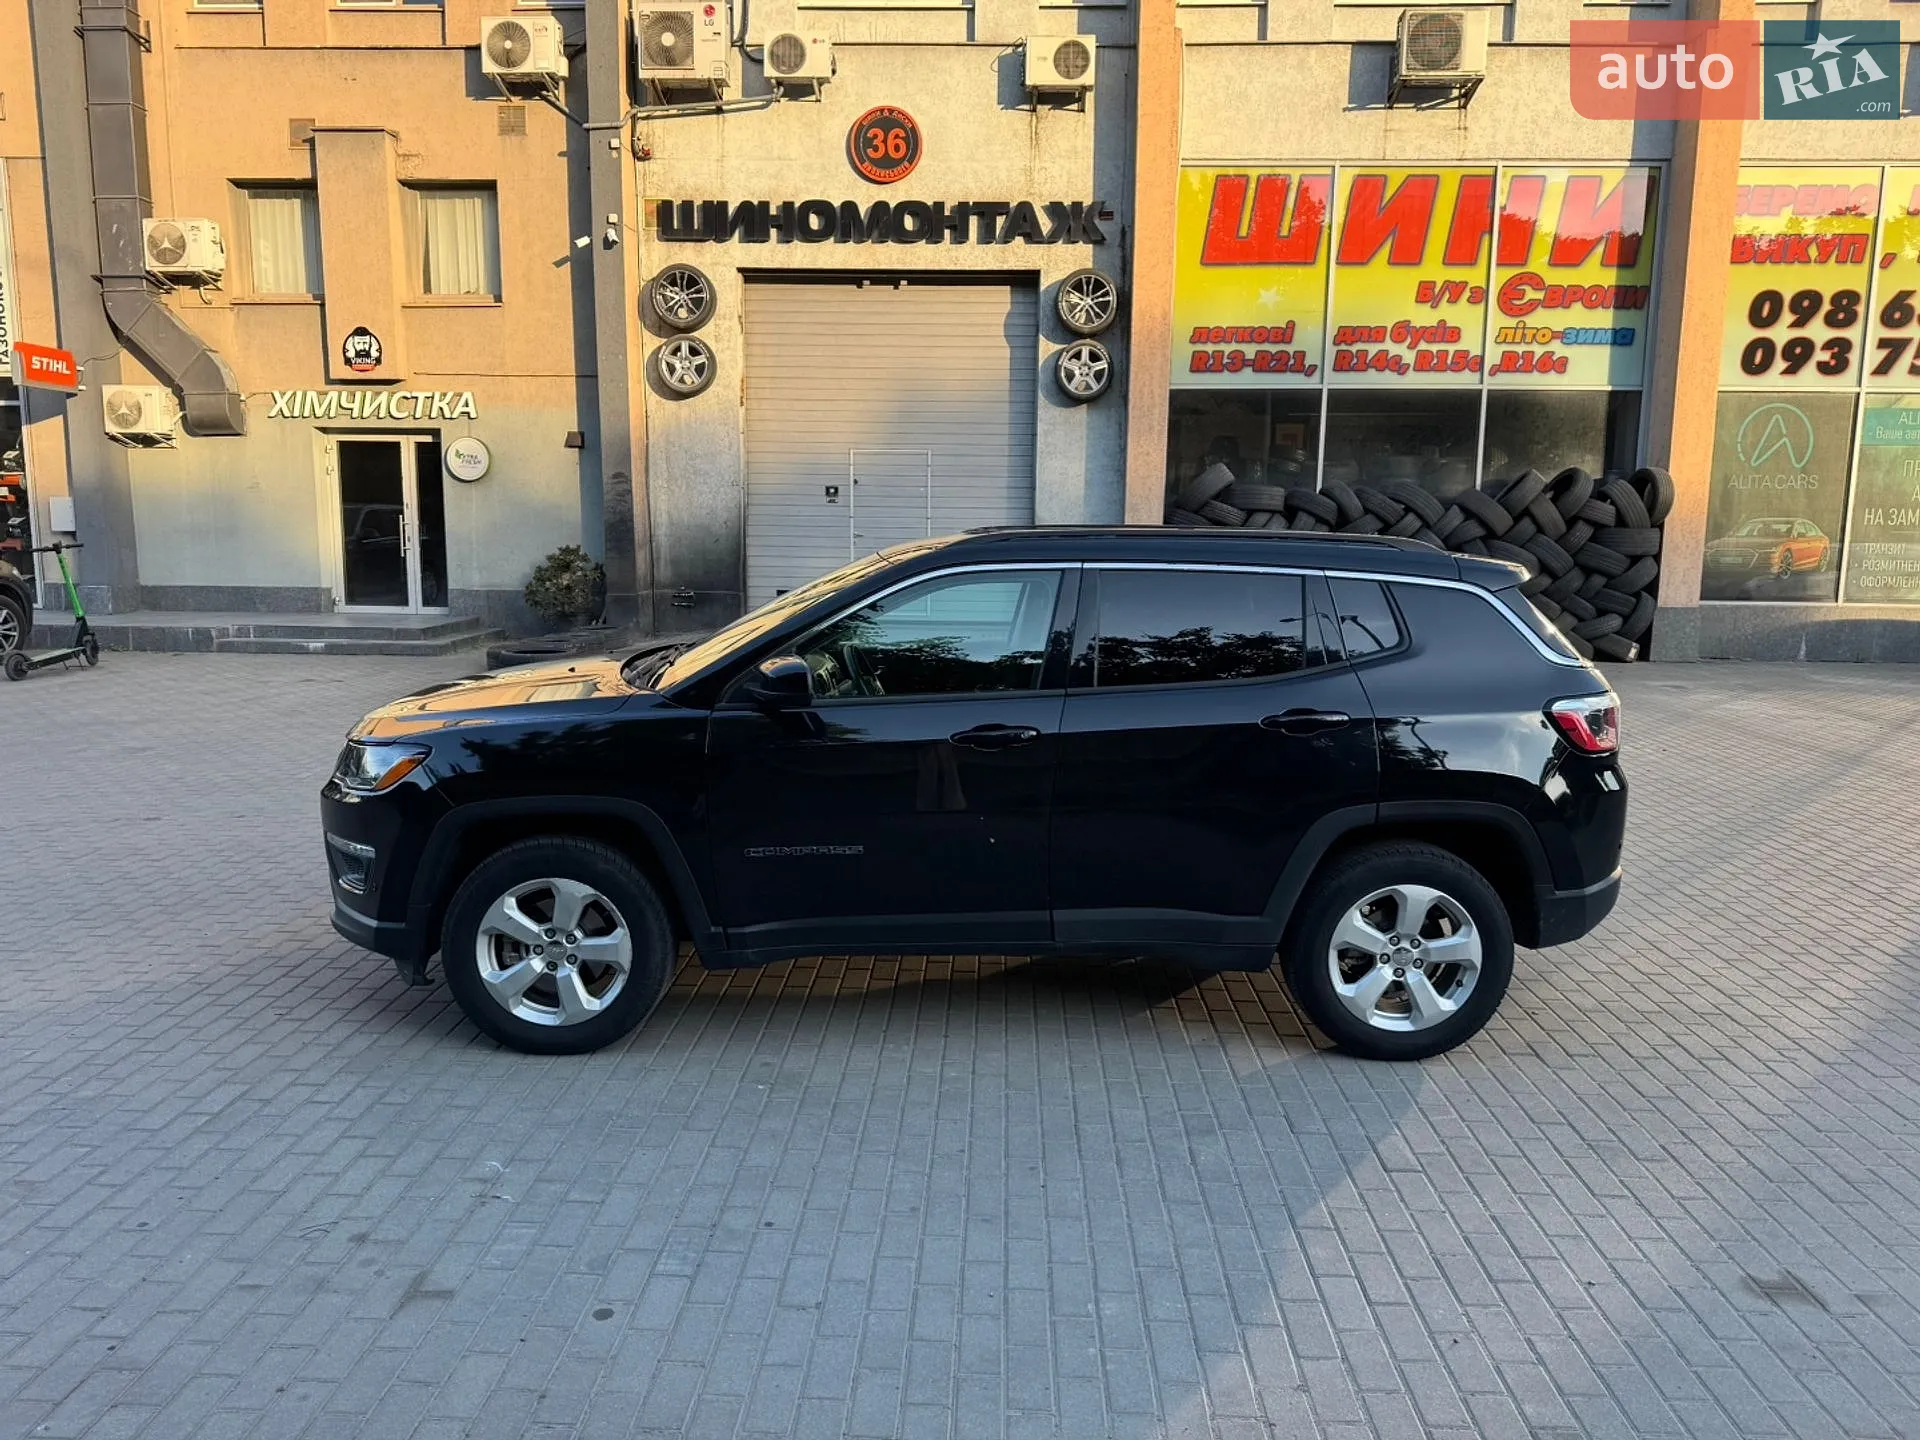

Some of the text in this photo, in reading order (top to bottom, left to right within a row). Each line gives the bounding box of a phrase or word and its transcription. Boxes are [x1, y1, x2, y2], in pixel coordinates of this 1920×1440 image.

[866, 128, 907, 159] 36
[658, 200, 1106, 245] ШИНОМОНТАЖ
[1201, 174, 1656, 267] ШИНИ
[1415, 280, 1468, 308] Б/У
[1748, 289, 1920, 329] 098 6
[1190, 320, 1296, 345] легкові
[1333, 320, 1461, 349] для бусів
[1495, 321, 1636, 346] літо-зима
[31, 356, 71, 375] STIHL
[1189, 350, 1318, 377] R13-R21,
[1741, 337, 1853, 376] 093
[268, 391, 478, 419] ХІМЧИСТКА
[1728, 474, 1819, 489] ALITA CARS
[1863, 507, 1884, 526] НА
